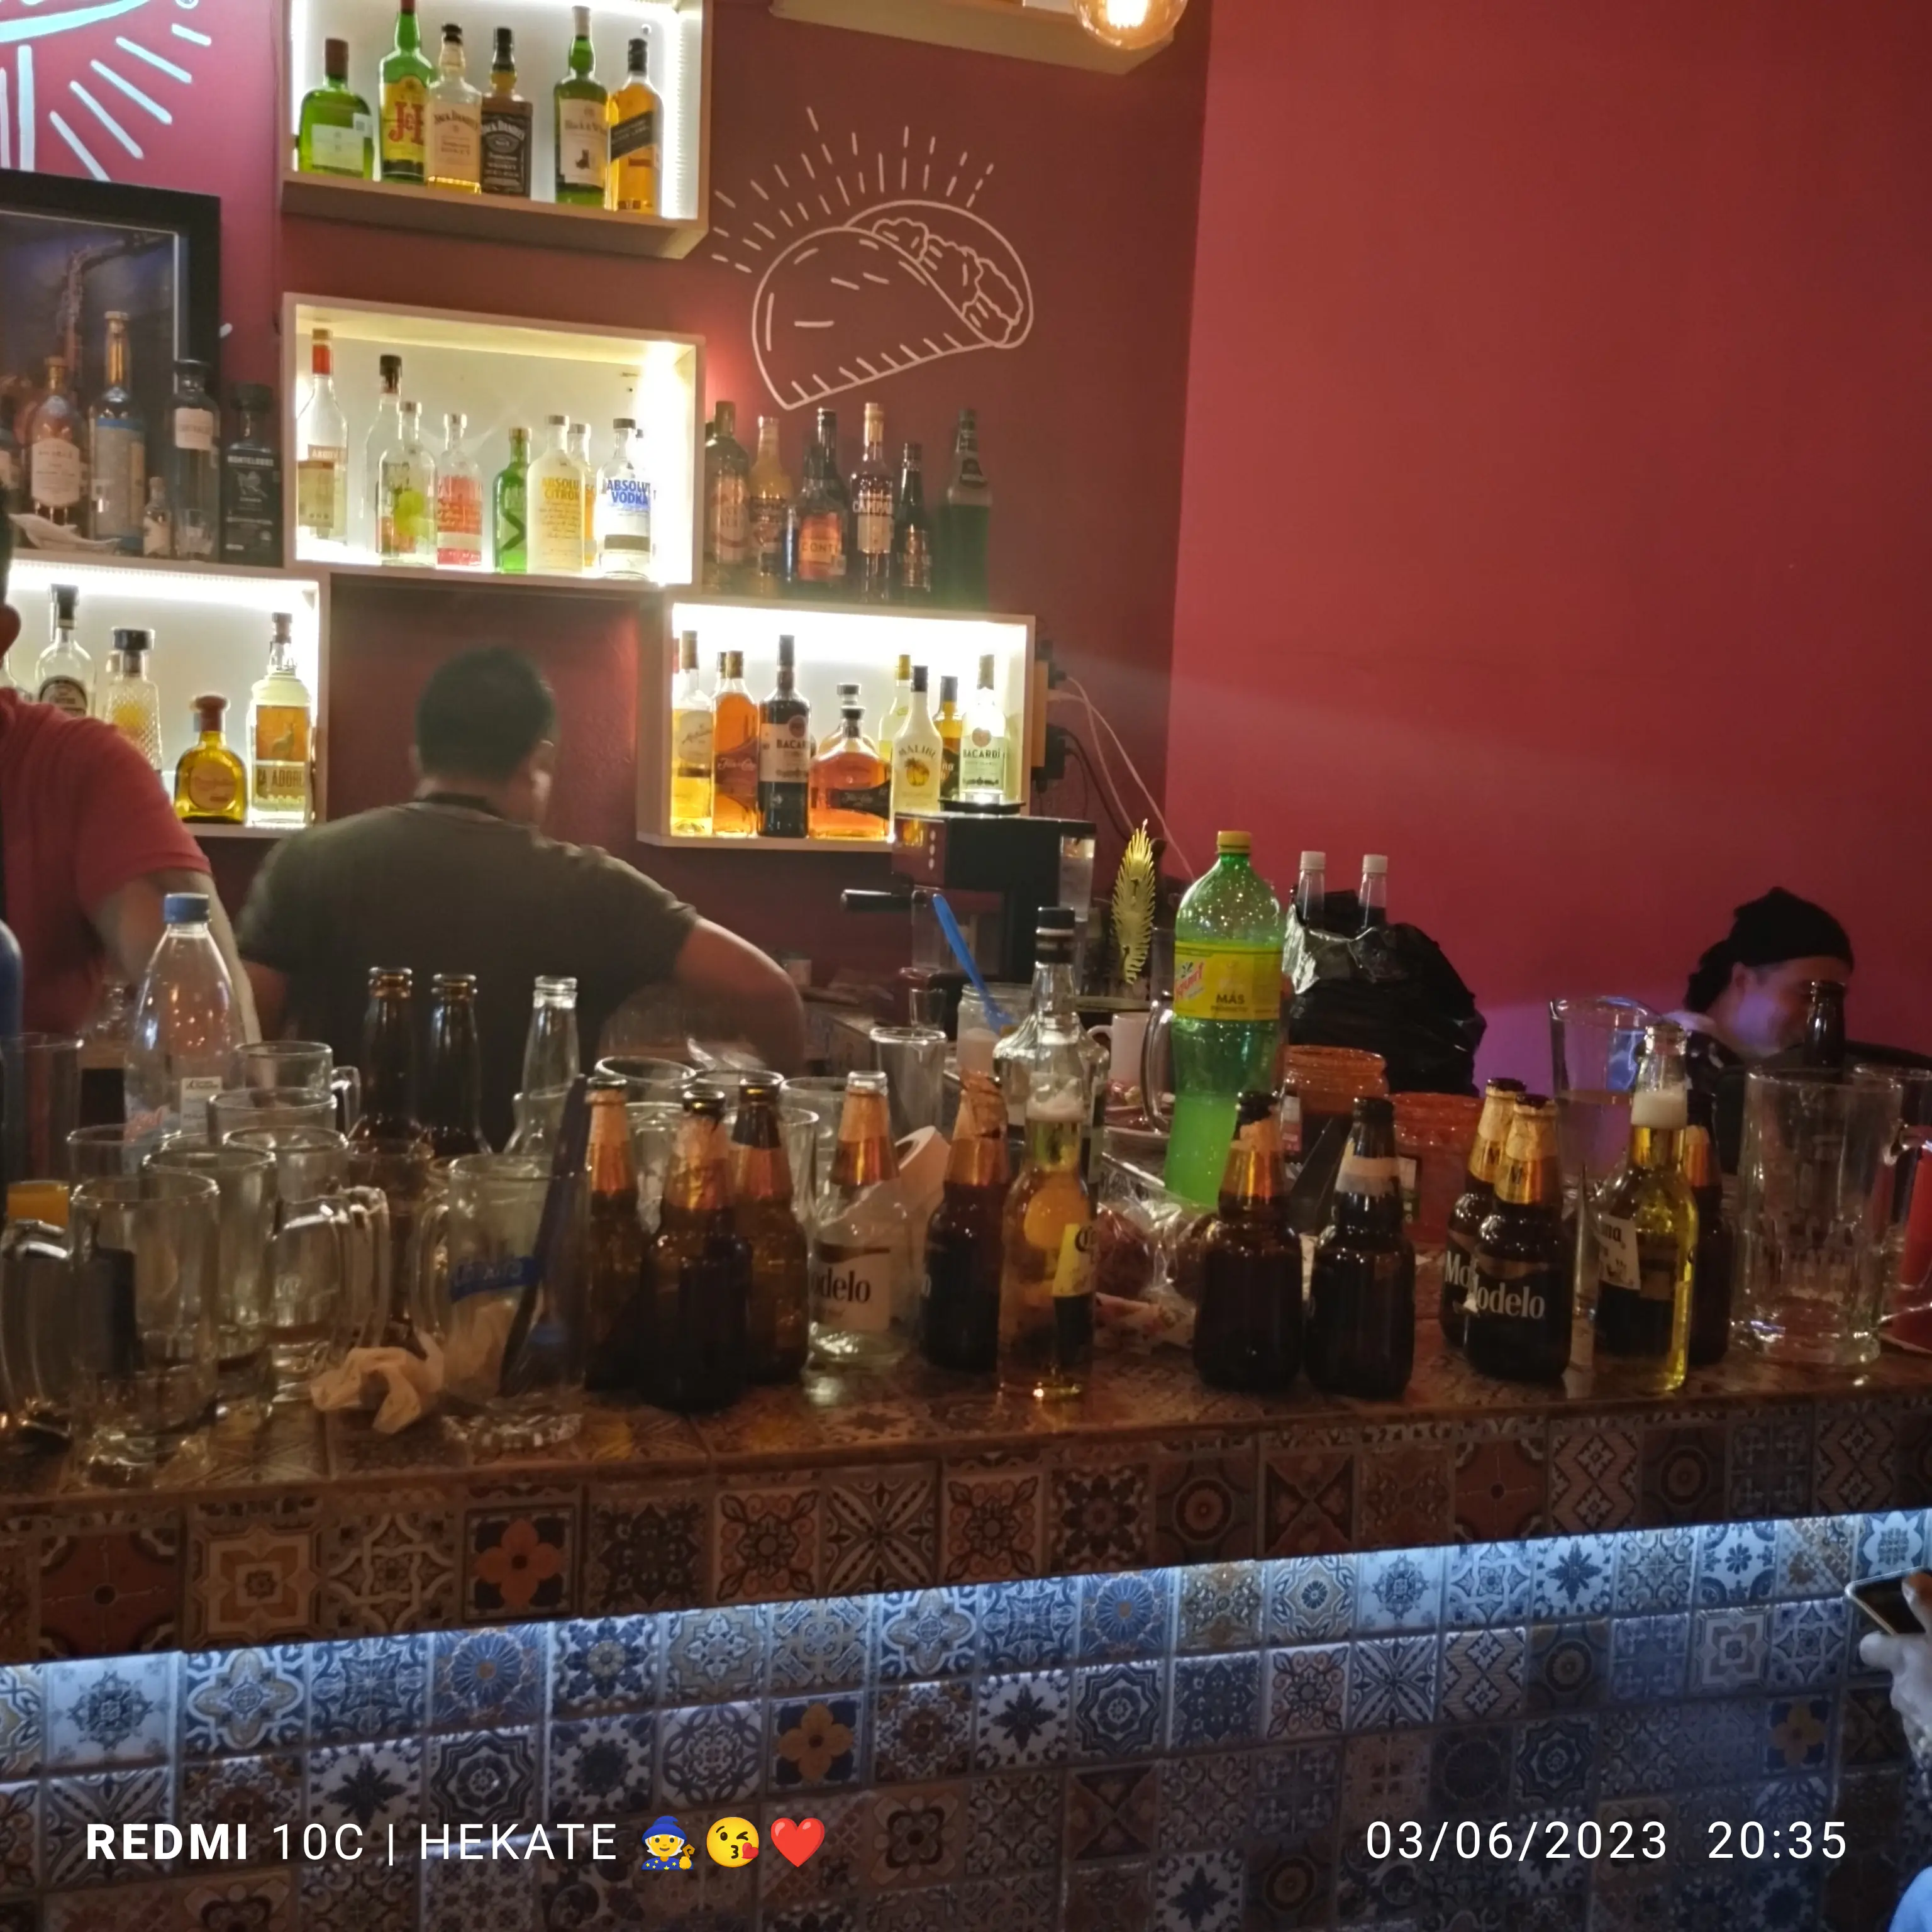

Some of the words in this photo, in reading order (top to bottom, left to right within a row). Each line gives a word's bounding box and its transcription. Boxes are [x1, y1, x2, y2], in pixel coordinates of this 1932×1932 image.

[543, 477, 580, 490] ABSOLU
[611, 492, 648, 506] VODKA
[1216, 989, 1245, 1005] MÁS
[813, 1267, 871, 1304] delo
